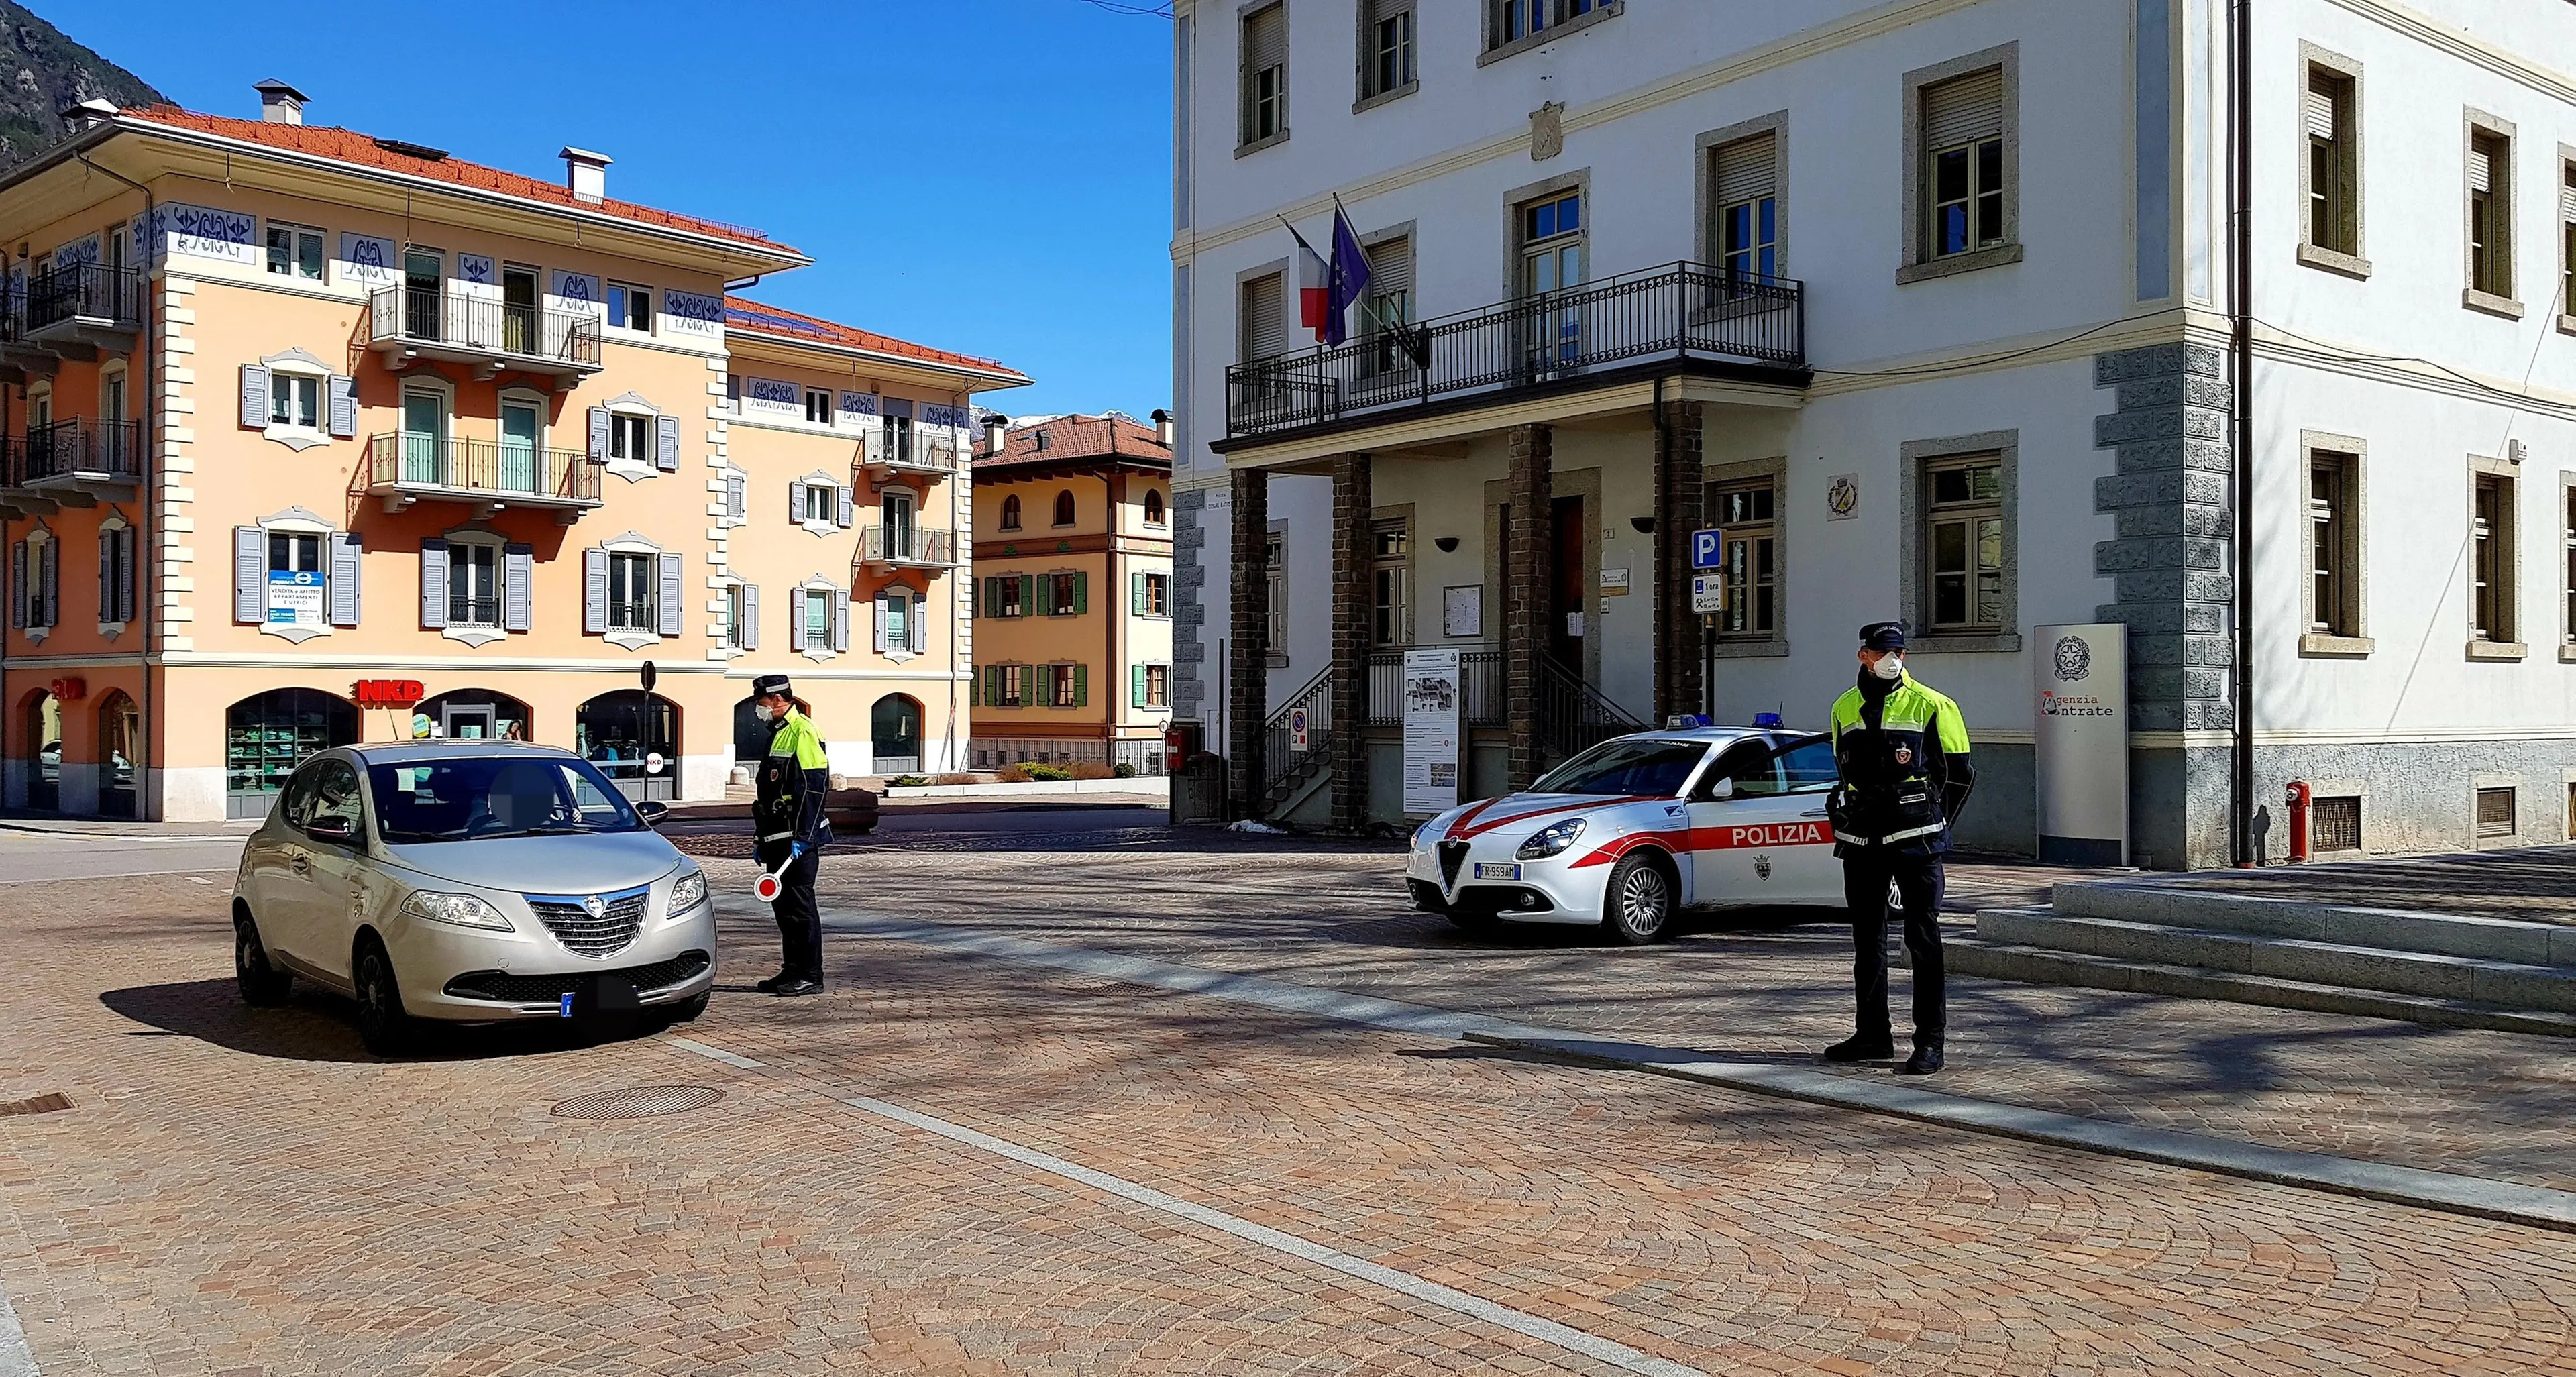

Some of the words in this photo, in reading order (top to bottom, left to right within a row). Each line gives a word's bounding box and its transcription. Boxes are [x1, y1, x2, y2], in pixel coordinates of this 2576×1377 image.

[1698, 534, 1715, 564] P
[358, 679, 424, 701] NKD
[1732, 824, 1822, 846] POLIZIA
